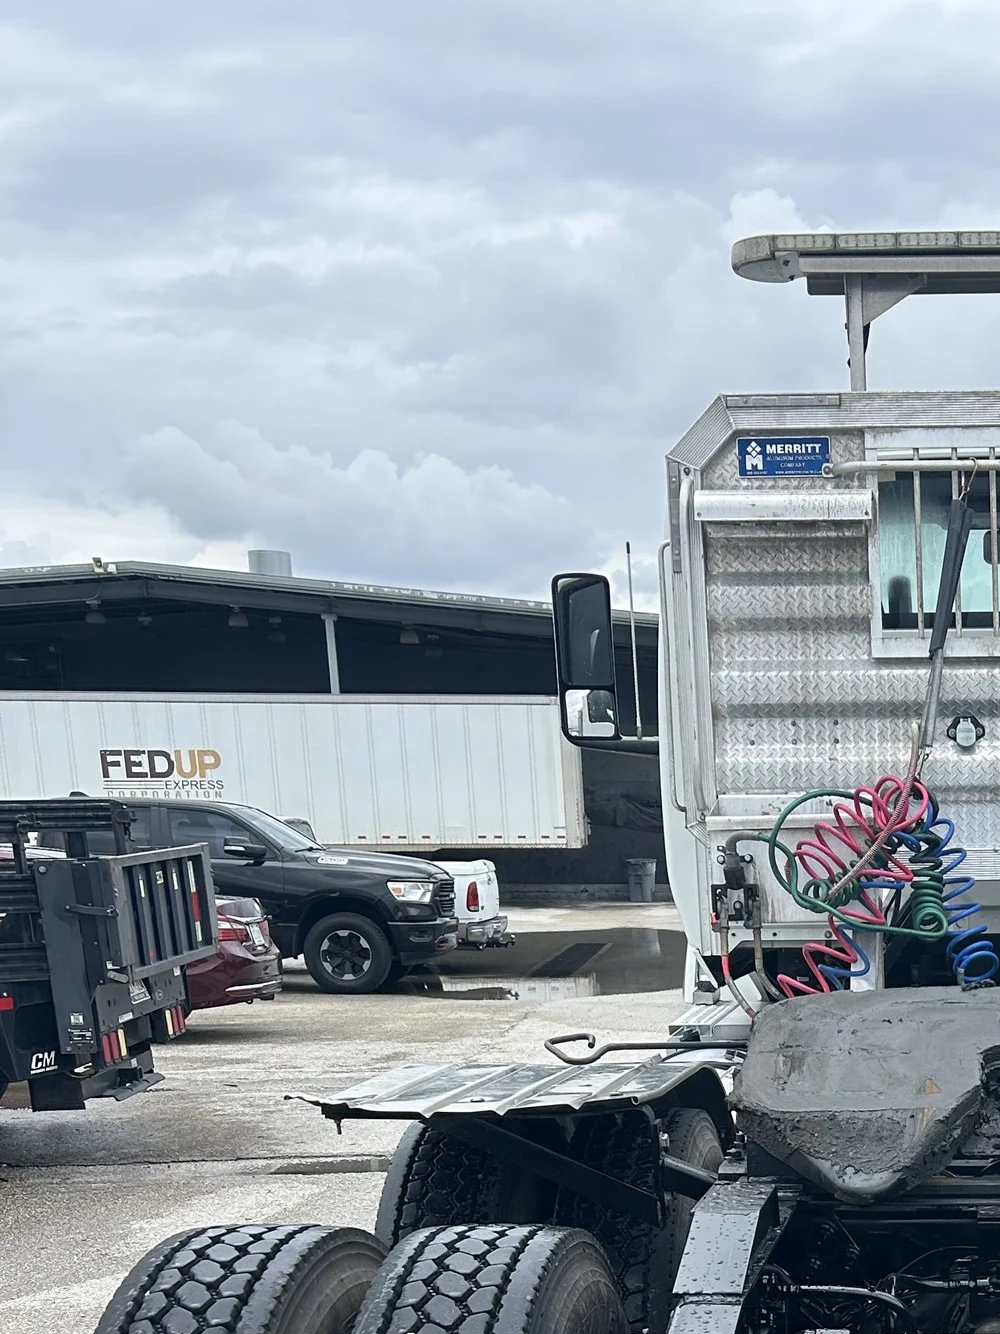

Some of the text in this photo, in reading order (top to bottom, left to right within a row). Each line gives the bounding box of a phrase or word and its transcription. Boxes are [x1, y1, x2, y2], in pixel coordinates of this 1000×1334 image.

[765, 443, 822, 454] MERRITT
[100, 749, 222, 779] FEDUP
[164, 780, 225, 790] EXPRESS
[107, 790, 223, 799] CORPORATION
[31, 1050, 56, 1070] CM
